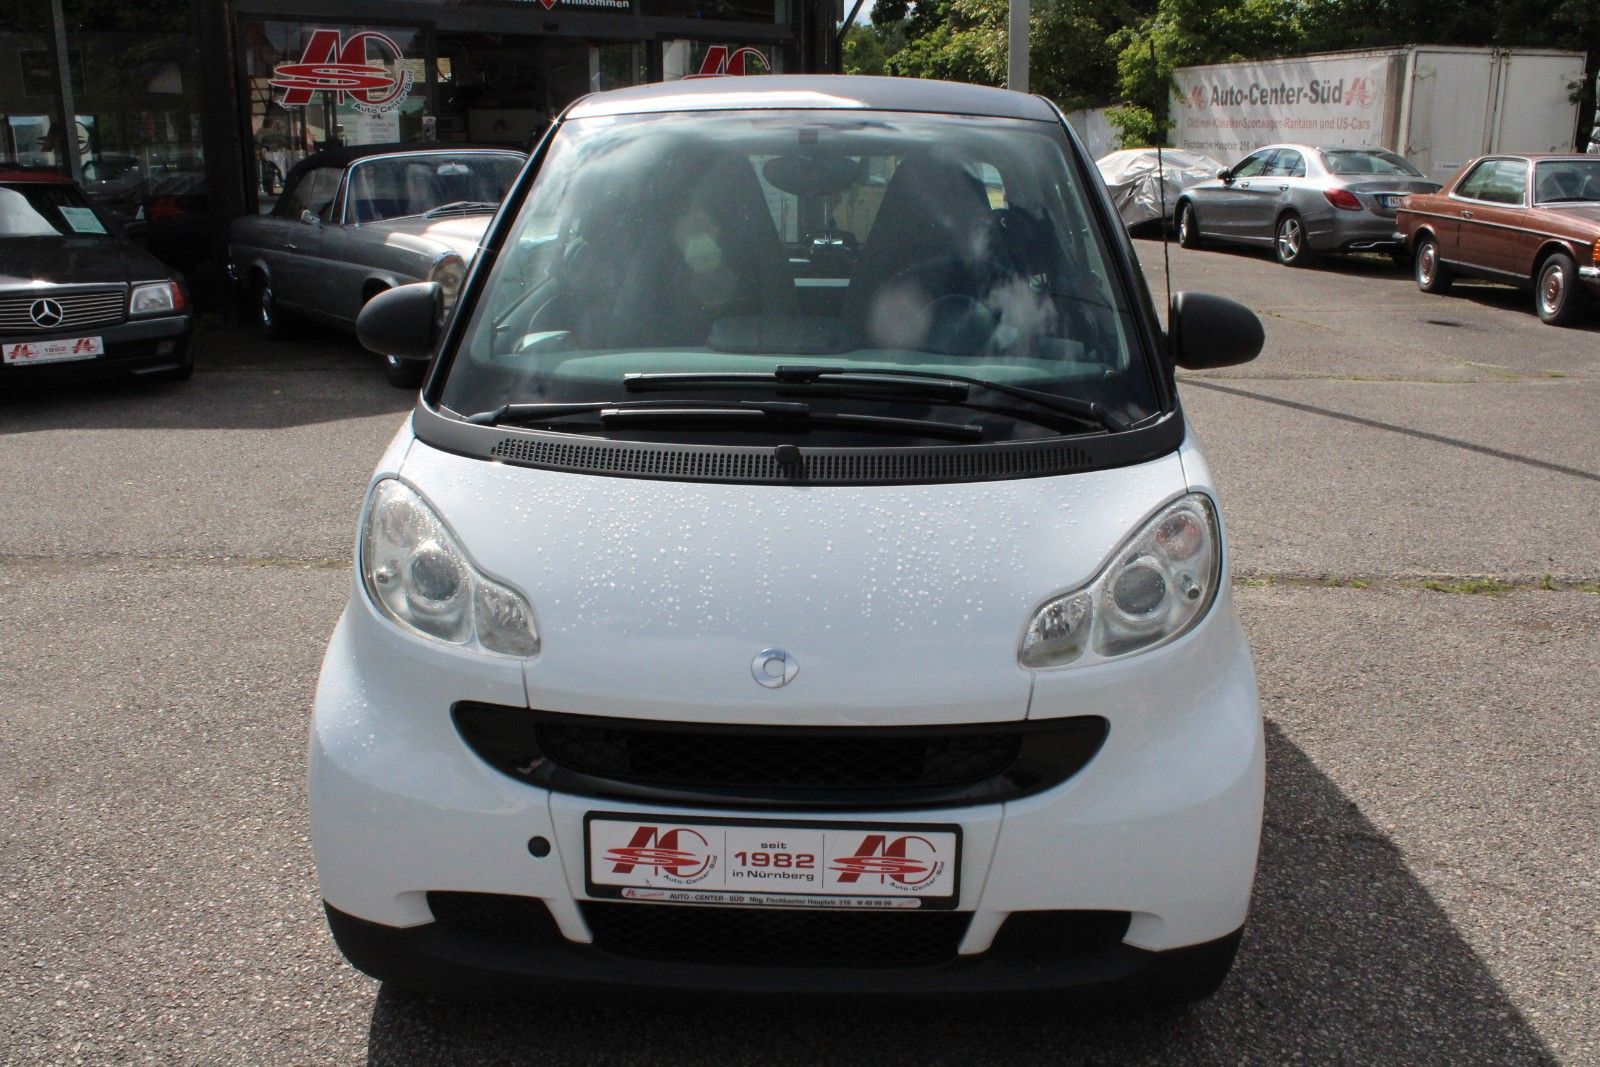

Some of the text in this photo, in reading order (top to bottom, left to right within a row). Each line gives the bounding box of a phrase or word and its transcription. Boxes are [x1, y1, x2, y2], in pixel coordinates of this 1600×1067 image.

[1209, 79, 1344, 107] Auto-Center-Süd
[354, 103, 378, 114] Auto
[380, 92, 409, 114] Center
[1320, 117, 1335, 130] und
[1336, 116, 1371, 131] US-Cars
[760, 841, 787, 850] seit
[734, 851, 815, 869] 1982
[732, 869, 815, 882] in Nürnberg
